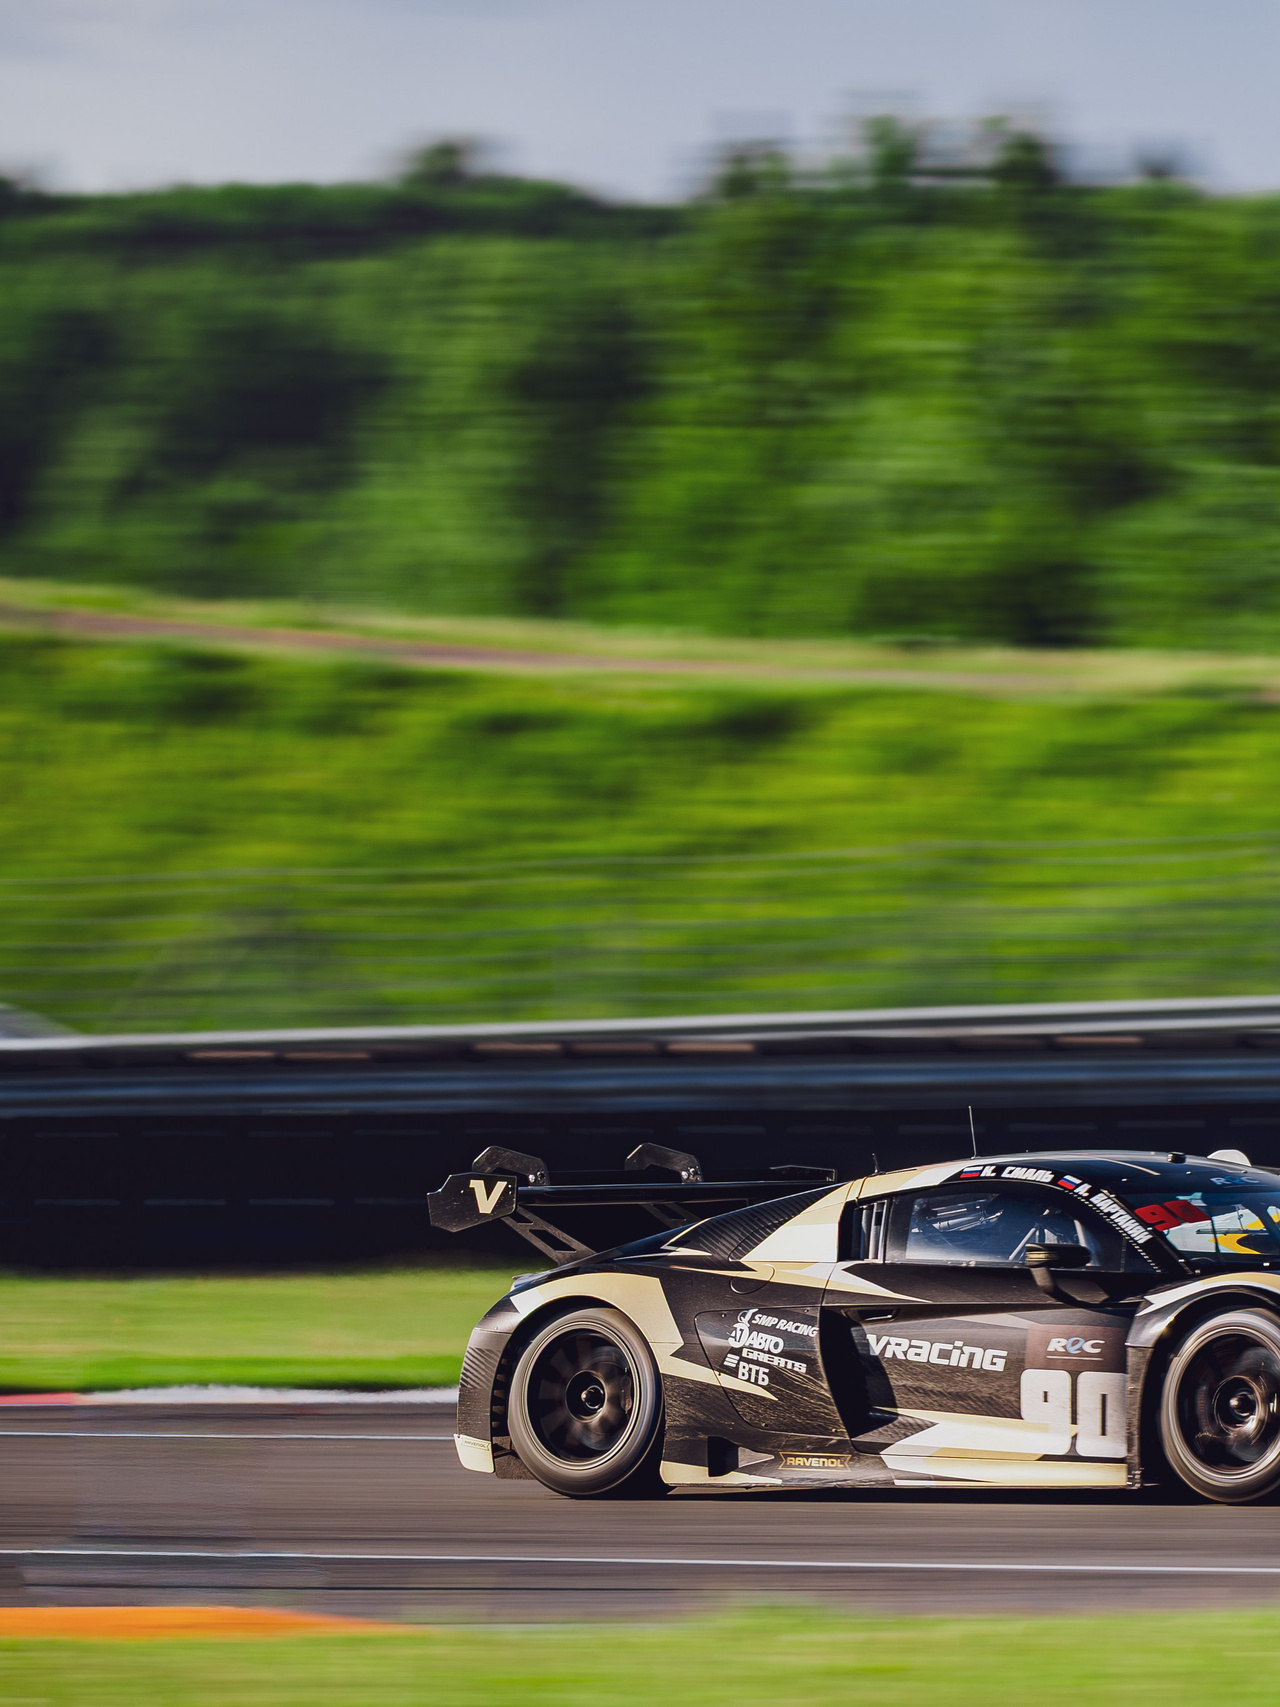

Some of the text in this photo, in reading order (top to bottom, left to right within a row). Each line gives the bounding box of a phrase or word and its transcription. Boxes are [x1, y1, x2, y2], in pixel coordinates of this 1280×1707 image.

[1001, 1166, 1055, 1183] СМАЛЬ
[1134, 1200, 1212, 1232] 90
[752, 1313, 820, 1338] SMP RACING
[741, 1347, 807, 1374] GREATS
[738, 1361, 770, 1386] ВТБ
[1020, 1368, 1128, 1459] 90
[786, 1457, 845, 1467] RAVENOL
